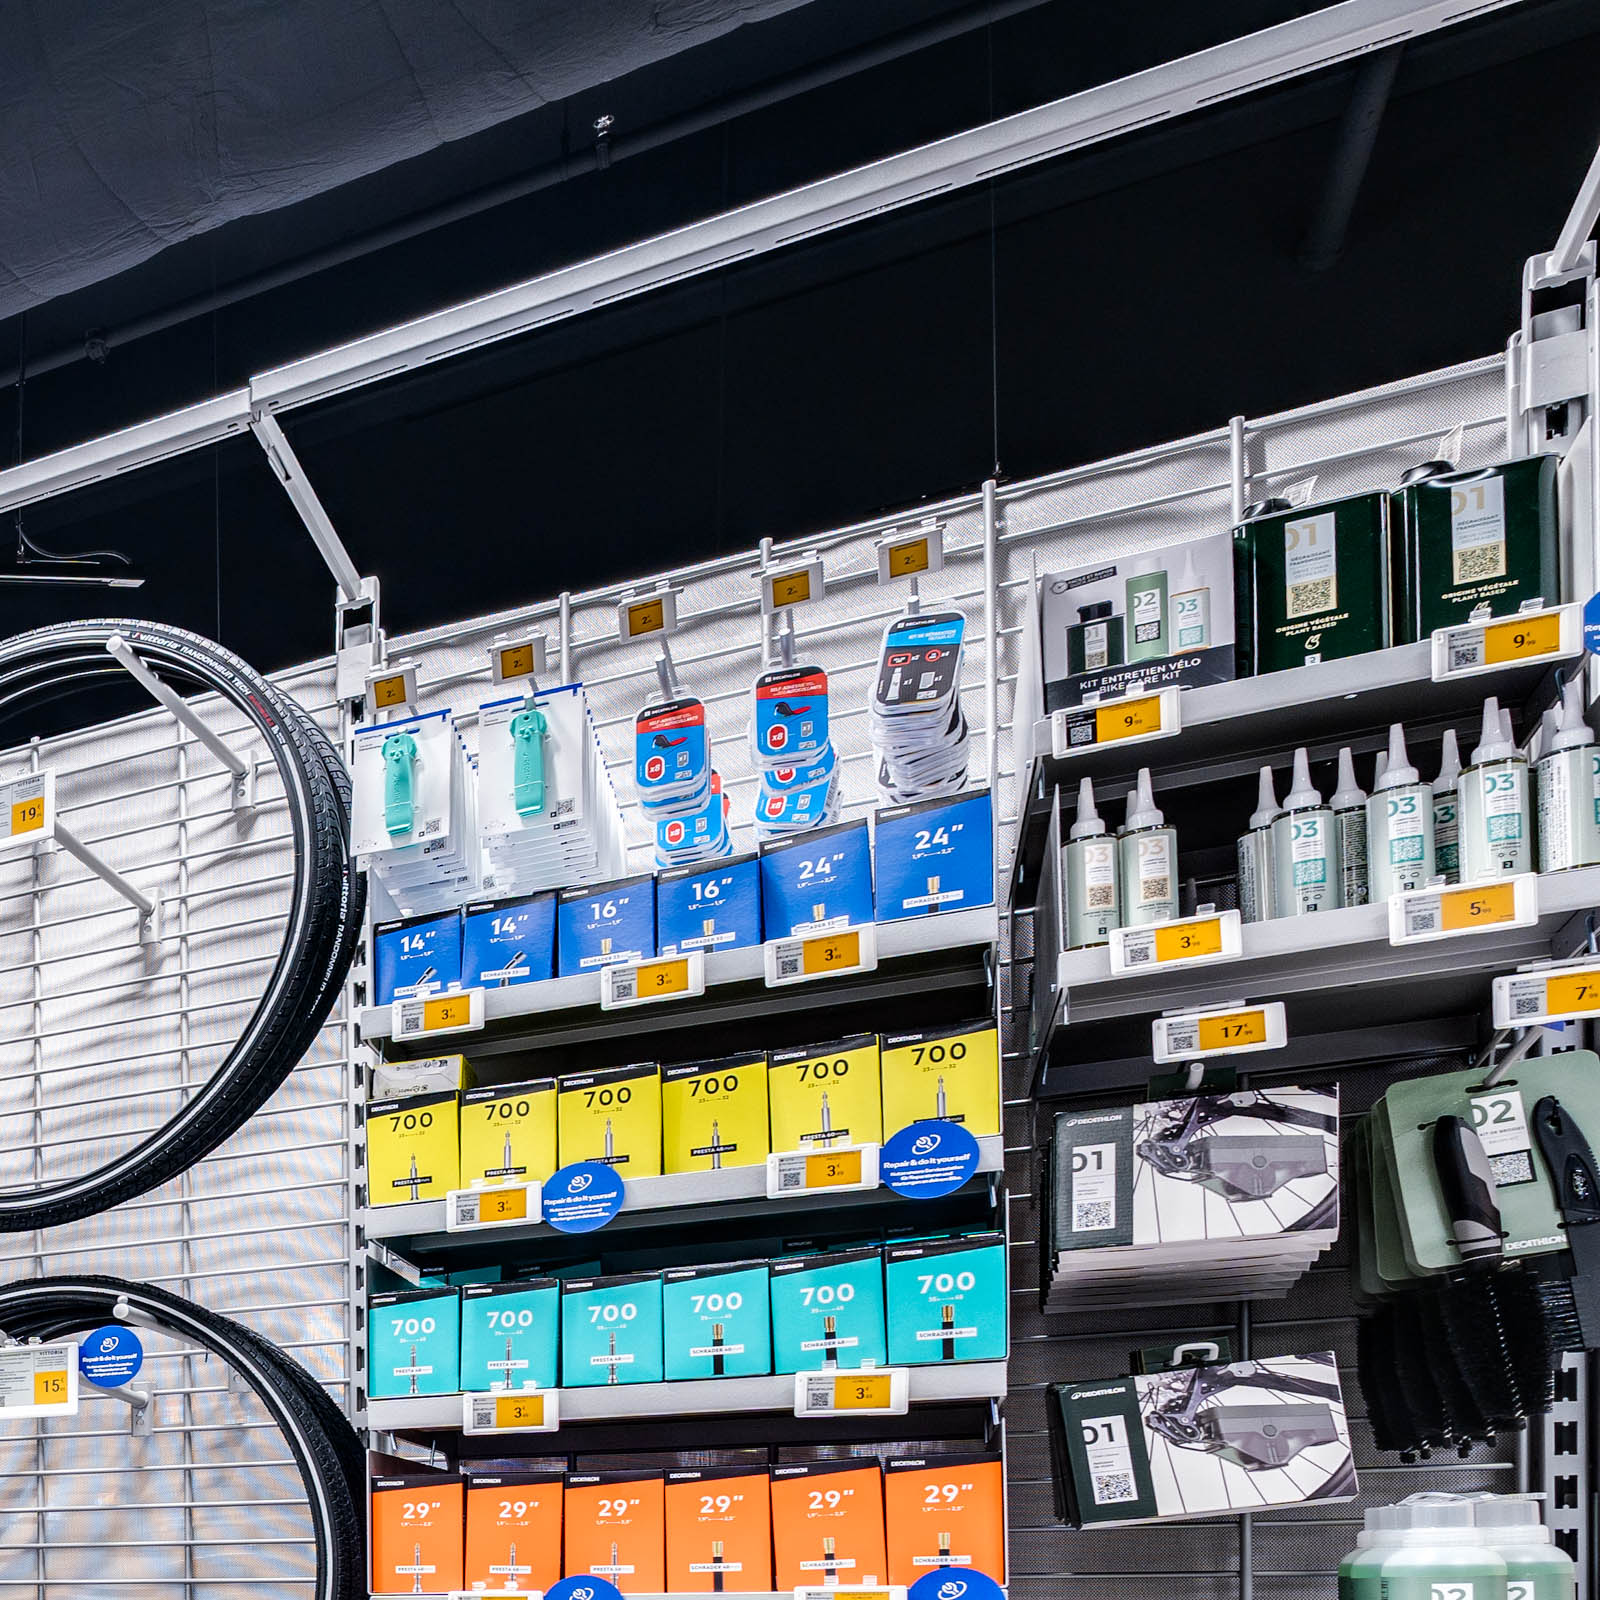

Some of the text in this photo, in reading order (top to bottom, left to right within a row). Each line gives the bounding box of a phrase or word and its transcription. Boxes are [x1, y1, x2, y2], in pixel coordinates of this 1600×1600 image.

[1080, 657, 1201, 690] KIT ENTRETIEN VÉLO
[1162, 670, 1181, 681] KIT
[911, 1042, 967, 1066] 700
[796, 1059, 849, 1082] 700
[688, 1075, 739, 1097] 700
[484, 1100, 530, 1121] 700
[1077, 1114, 1122, 1126] DECATHLON
[917, 1271, 976, 1295] 700
[799, 1283, 855, 1307] 700
[587, 1303, 638, 1323] 700
[391, 1317, 436, 1337] 700
[1082, 1386, 1126, 1399] DECATHLON
